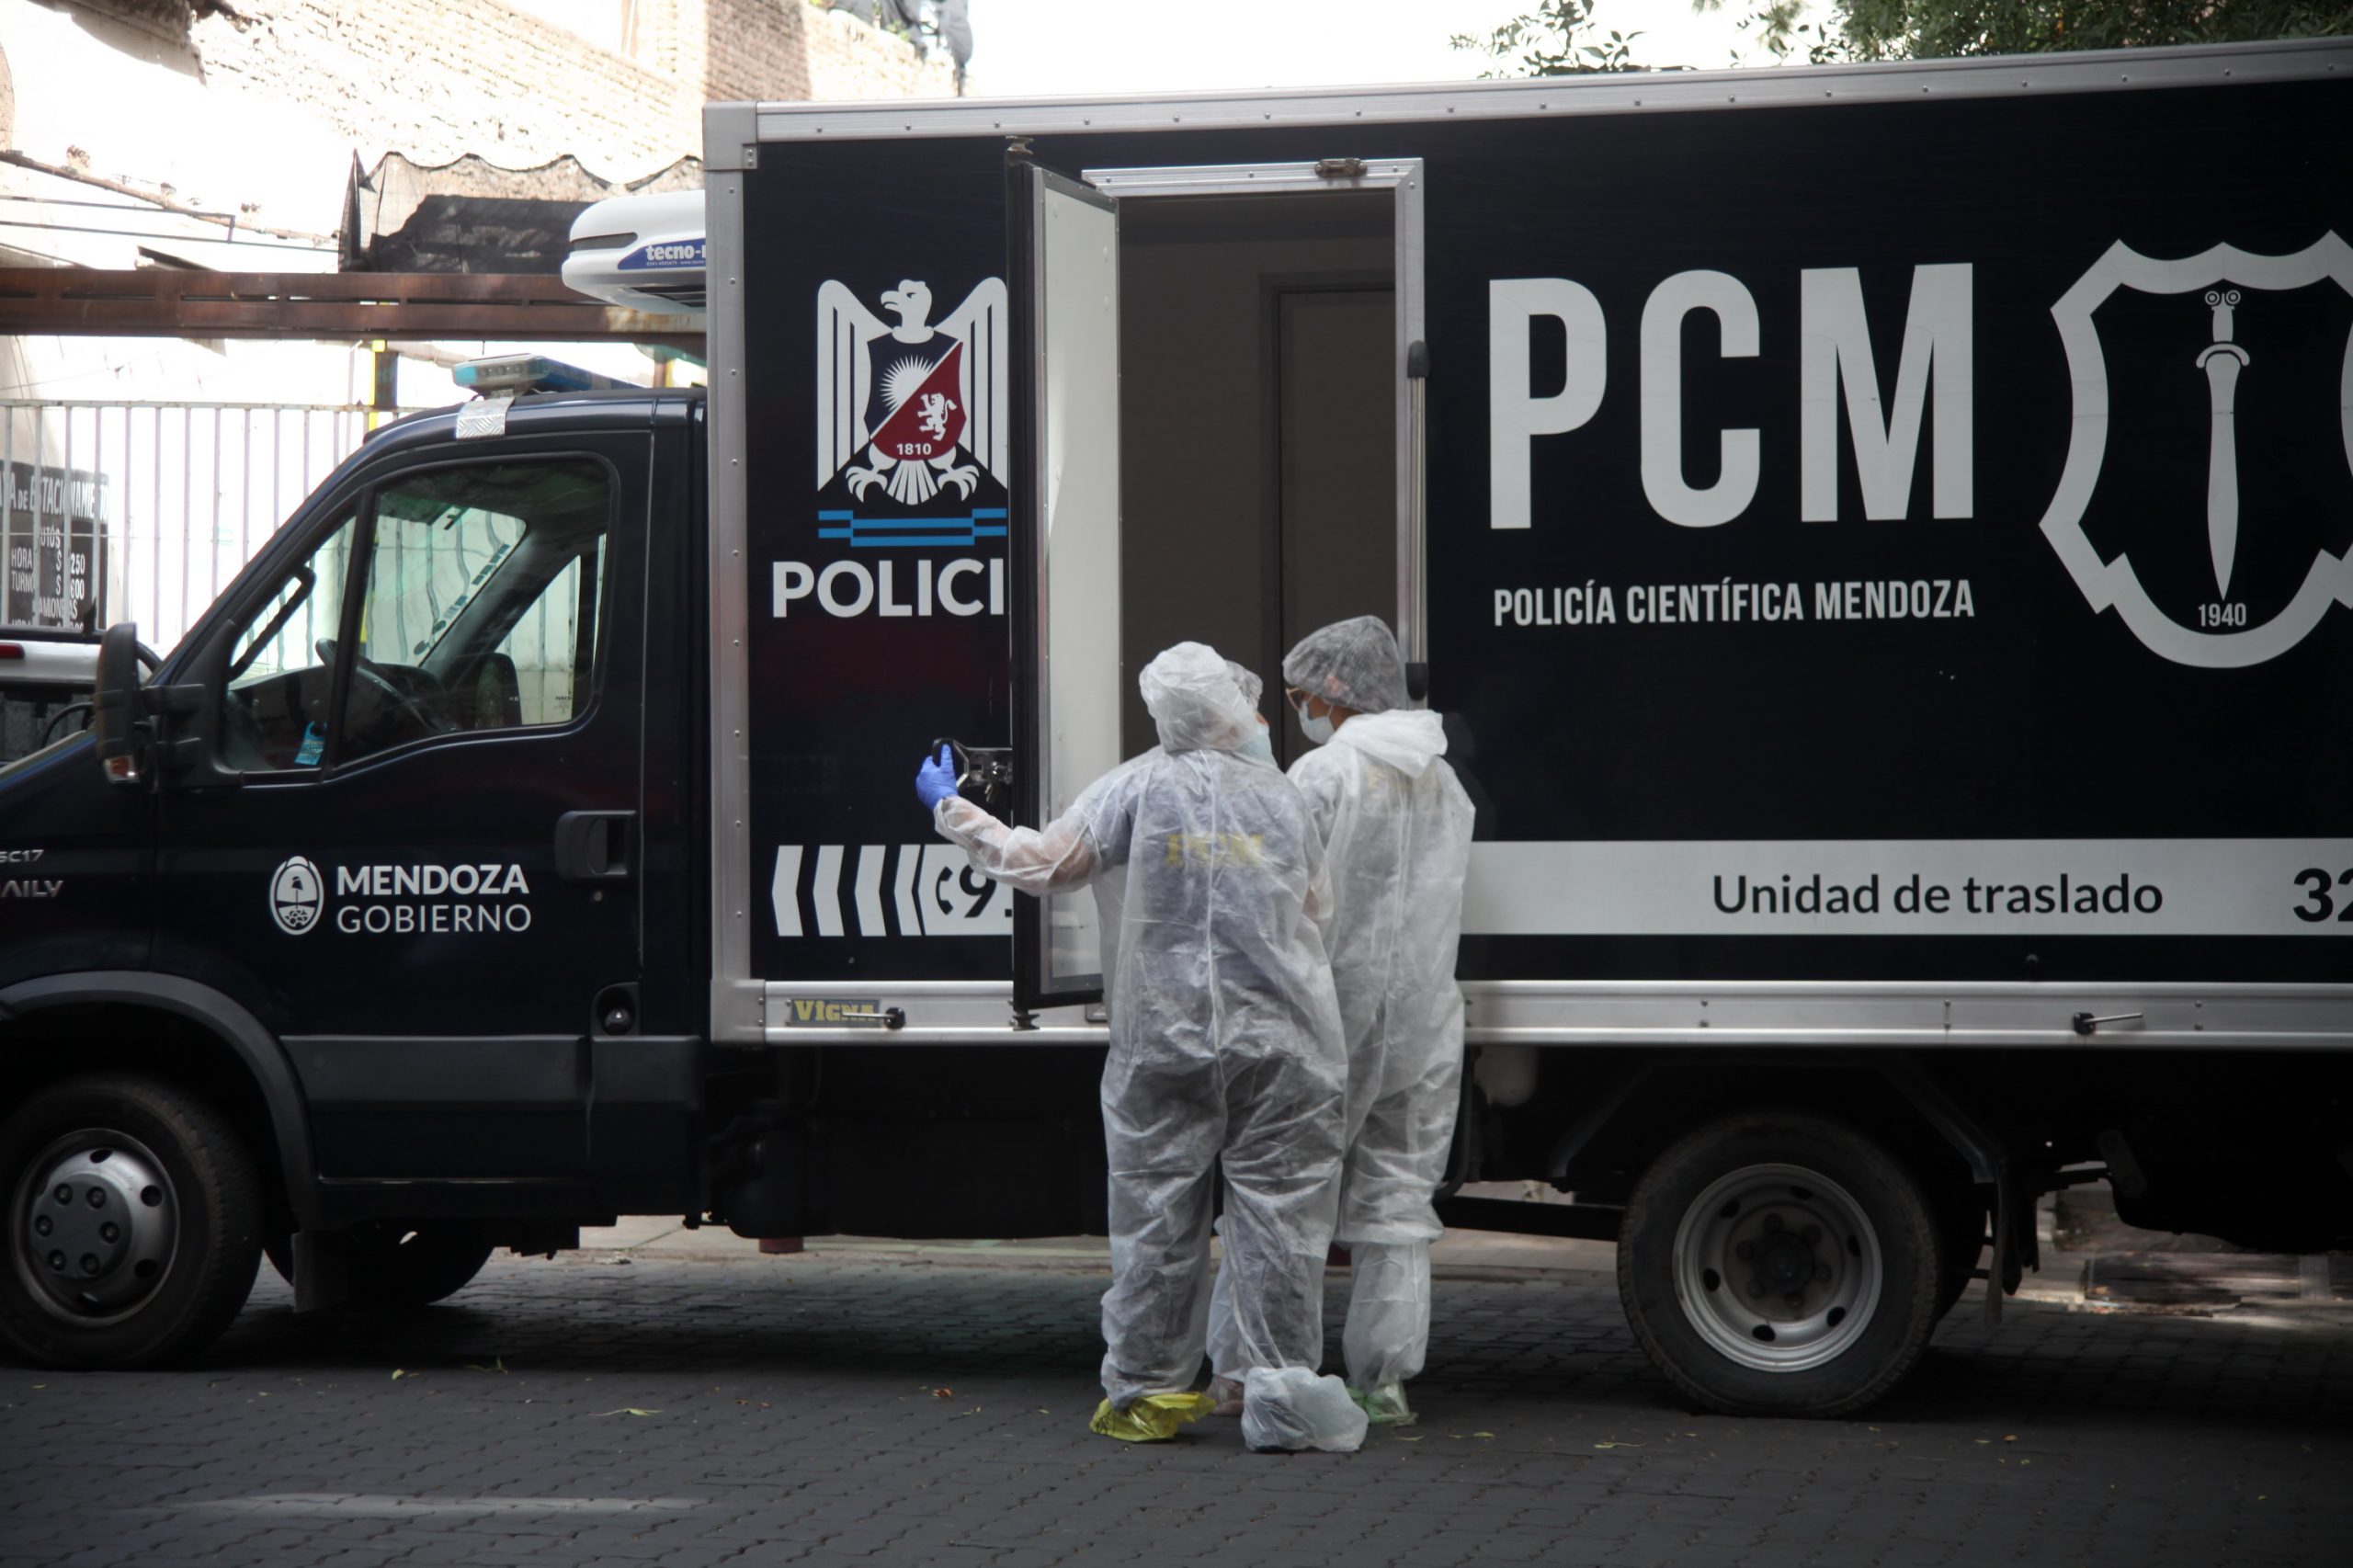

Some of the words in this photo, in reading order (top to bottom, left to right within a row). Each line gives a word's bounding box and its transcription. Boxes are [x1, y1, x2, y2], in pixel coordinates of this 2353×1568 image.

[1490, 263, 1973, 529] PCM
[896, 443, 932, 456] 1810
[11, 547, 33, 569] HORA
[71, 553, 85, 575] 250
[70, 578, 85, 599] 600
[1494, 580, 1616, 626] POLICÍA
[1626, 576, 1804, 623] CIENTÍFICA
[1814, 579, 1975, 619] MENDOZA
[2198, 603, 2247, 627] 1940
[337, 864, 529, 895] MENDOZA
[1712, 874, 1880, 915] Unidad
[1893, 874, 1950, 915] de
[1963, 873, 2164, 915] traslado
[337, 903, 531, 933] GOBIERNO
